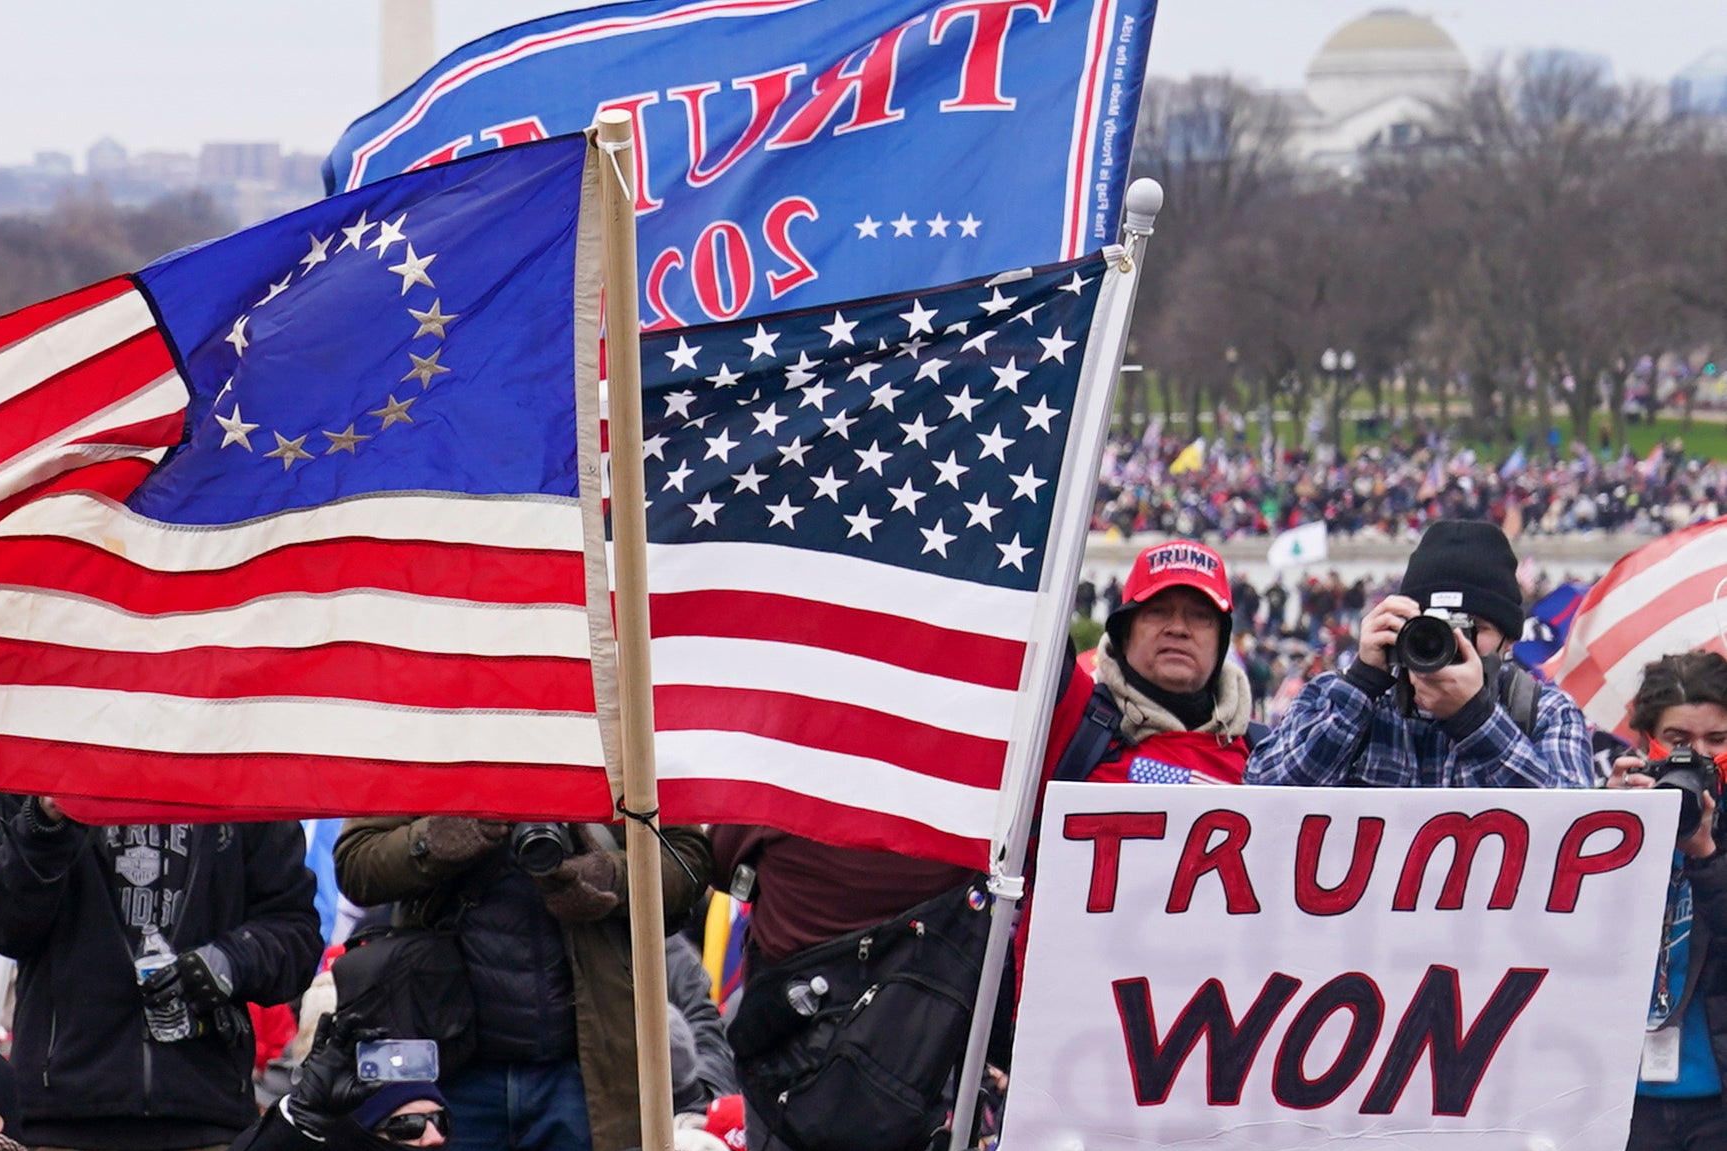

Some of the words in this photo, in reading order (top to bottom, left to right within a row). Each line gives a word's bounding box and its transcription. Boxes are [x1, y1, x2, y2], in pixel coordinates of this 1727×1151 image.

[1147, 548, 1218, 571] TRUMP
[1063, 809, 1646, 917] TRUMP
[1112, 964, 1549, 1118] WON
